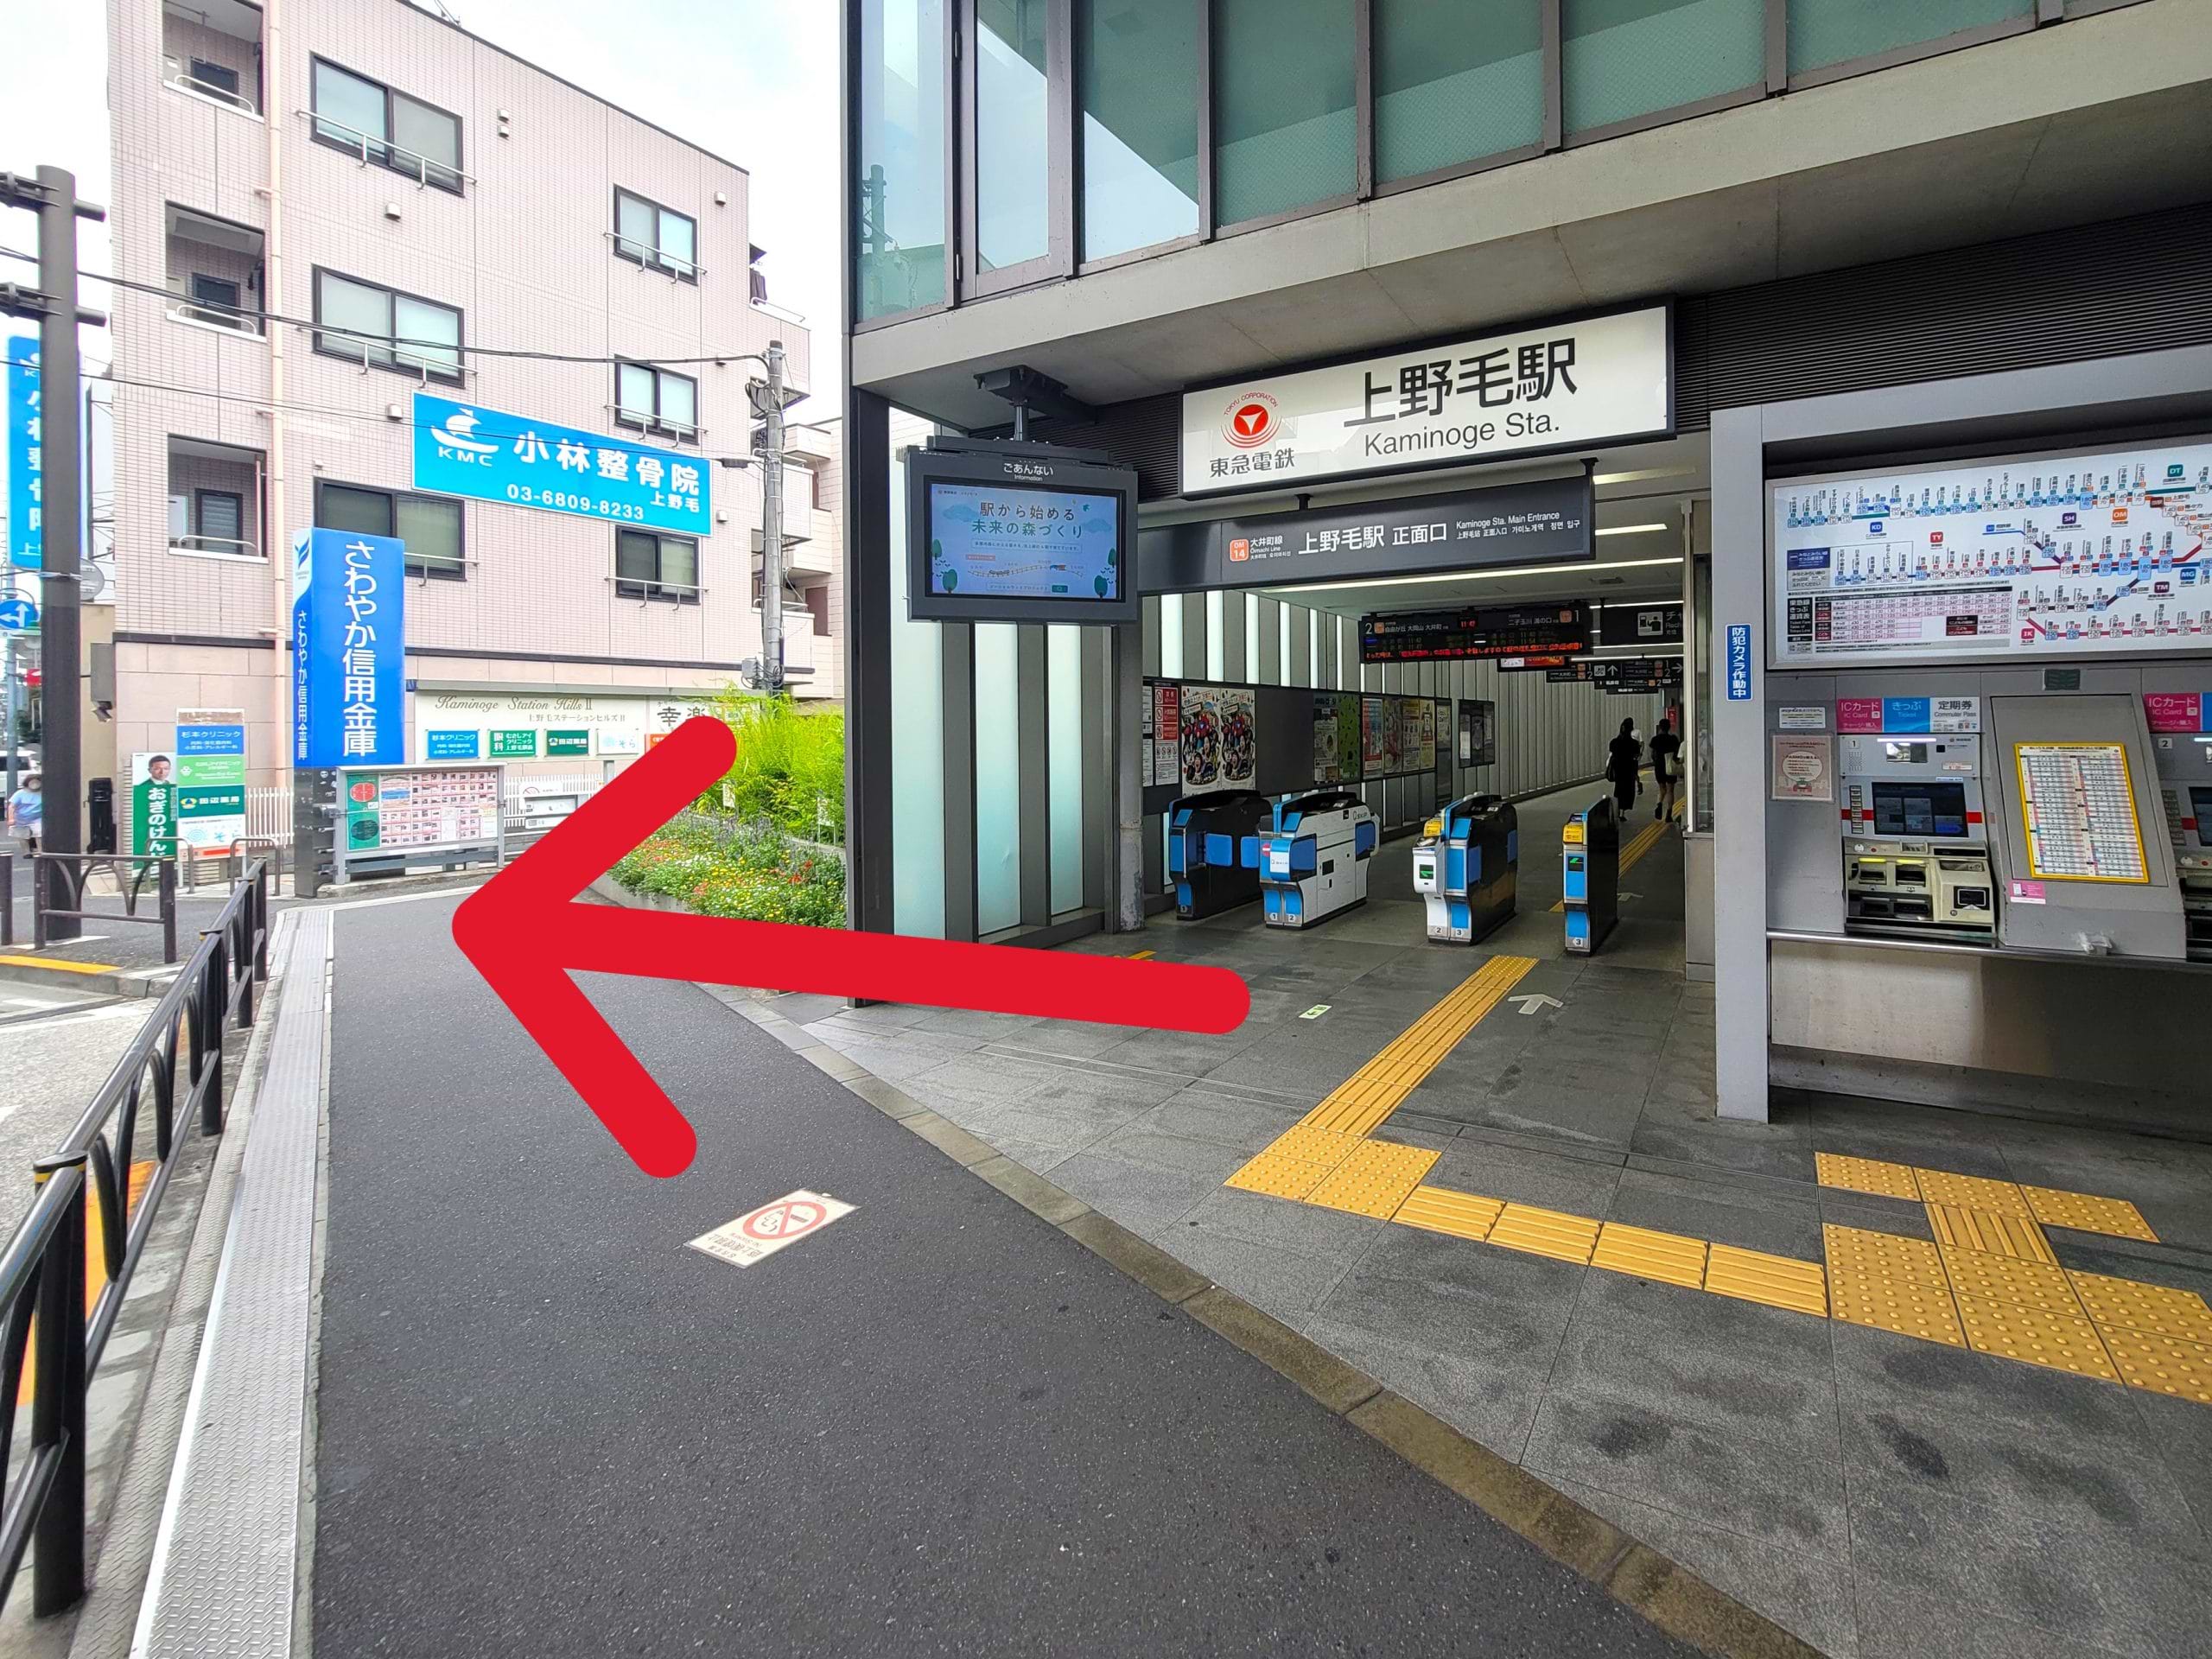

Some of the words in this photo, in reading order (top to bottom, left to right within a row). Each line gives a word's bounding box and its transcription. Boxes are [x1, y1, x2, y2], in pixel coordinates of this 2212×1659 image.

[1344, 337, 1578, 428] 上野毛駅
[1224, 398, 1240, 416] TOKYU
[1241, 392, 1279, 408] CORPORATION
[1364, 420, 1495, 457] Kaminoge
[1505, 411, 1560, 438] Sta.
[438, 446, 493, 467] KMC
[513, 431, 700, 496] 小林整骨院
[1210, 448, 1295, 478] 東急電鉄
[1003, 462, 1054, 475] ごあんない
[506, 483, 645, 520] 03-6809-8233
[650, 490, 700, 513] 上野毛
[980, 501, 1075, 521] 駅から始める
[972, 518, 1083, 538] 未来の森づくり
[1456, 520, 1491, 530] Kaminoge
[1508, 515, 1526, 524] Main
[1527, 512, 1560, 522] Entrance
[1250, 535, 1283, 548] 大井町線
[1298, 524, 1385, 556] 上野毛駅
[1392, 523, 1447, 546] 正面口
[1234, 550, 1245, 559] 14
[1575, 609, 1580, 622] 1
[1365, 622, 1372, 634] 2
[342, 541, 378, 756] さわやか信用金庫
[1732, 627, 1746, 698] 防犯カメラ作動中
[297, 609, 308, 760] さわやか信用金庫
[435, 695, 499, 713] Kaminoge
[507, 696, 549, 710] Station
[554, 697, 582, 710] Hills
[1840, 702, 1879, 711] ICカード
[1891, 701, 1922, 710] きっぷ
[1938, 701, 1973, 711] 定期券
[2149, 696, 2196, 708] ICカード
[493, 733, 504, 752] 眼科
[619, 739, 636, 749] そら
[148, 787, 167, 856] おぎのけん
